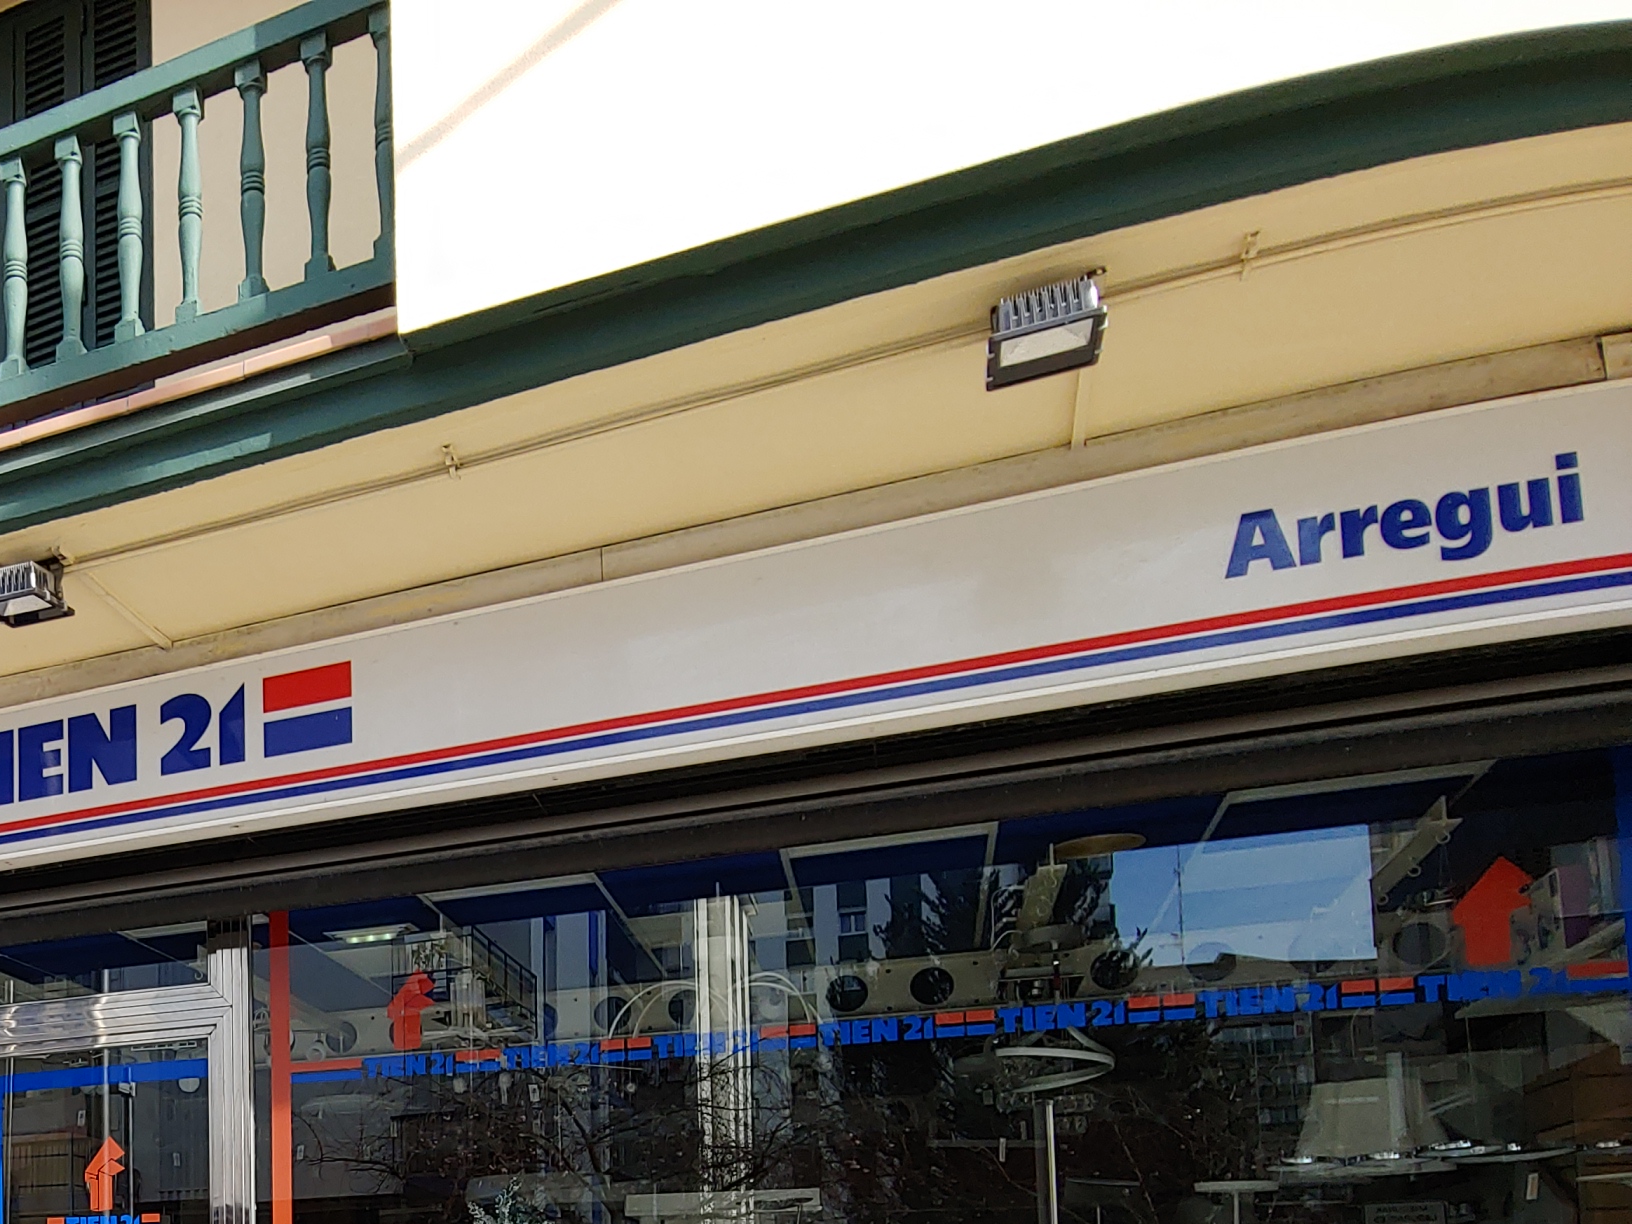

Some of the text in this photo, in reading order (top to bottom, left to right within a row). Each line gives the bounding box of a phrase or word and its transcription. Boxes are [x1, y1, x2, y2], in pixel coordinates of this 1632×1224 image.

[1225, 451, 1585, 579] Arregui
[160, 682, 246, 776] 21
[998, 1001, 1126, 1033] TIEN 21
[1198, 985, 1296, 1018] TIEN
[818, 1015, 935, 1046] TIEN 21
[364, 1052, 454, 1078] TIEN 21
